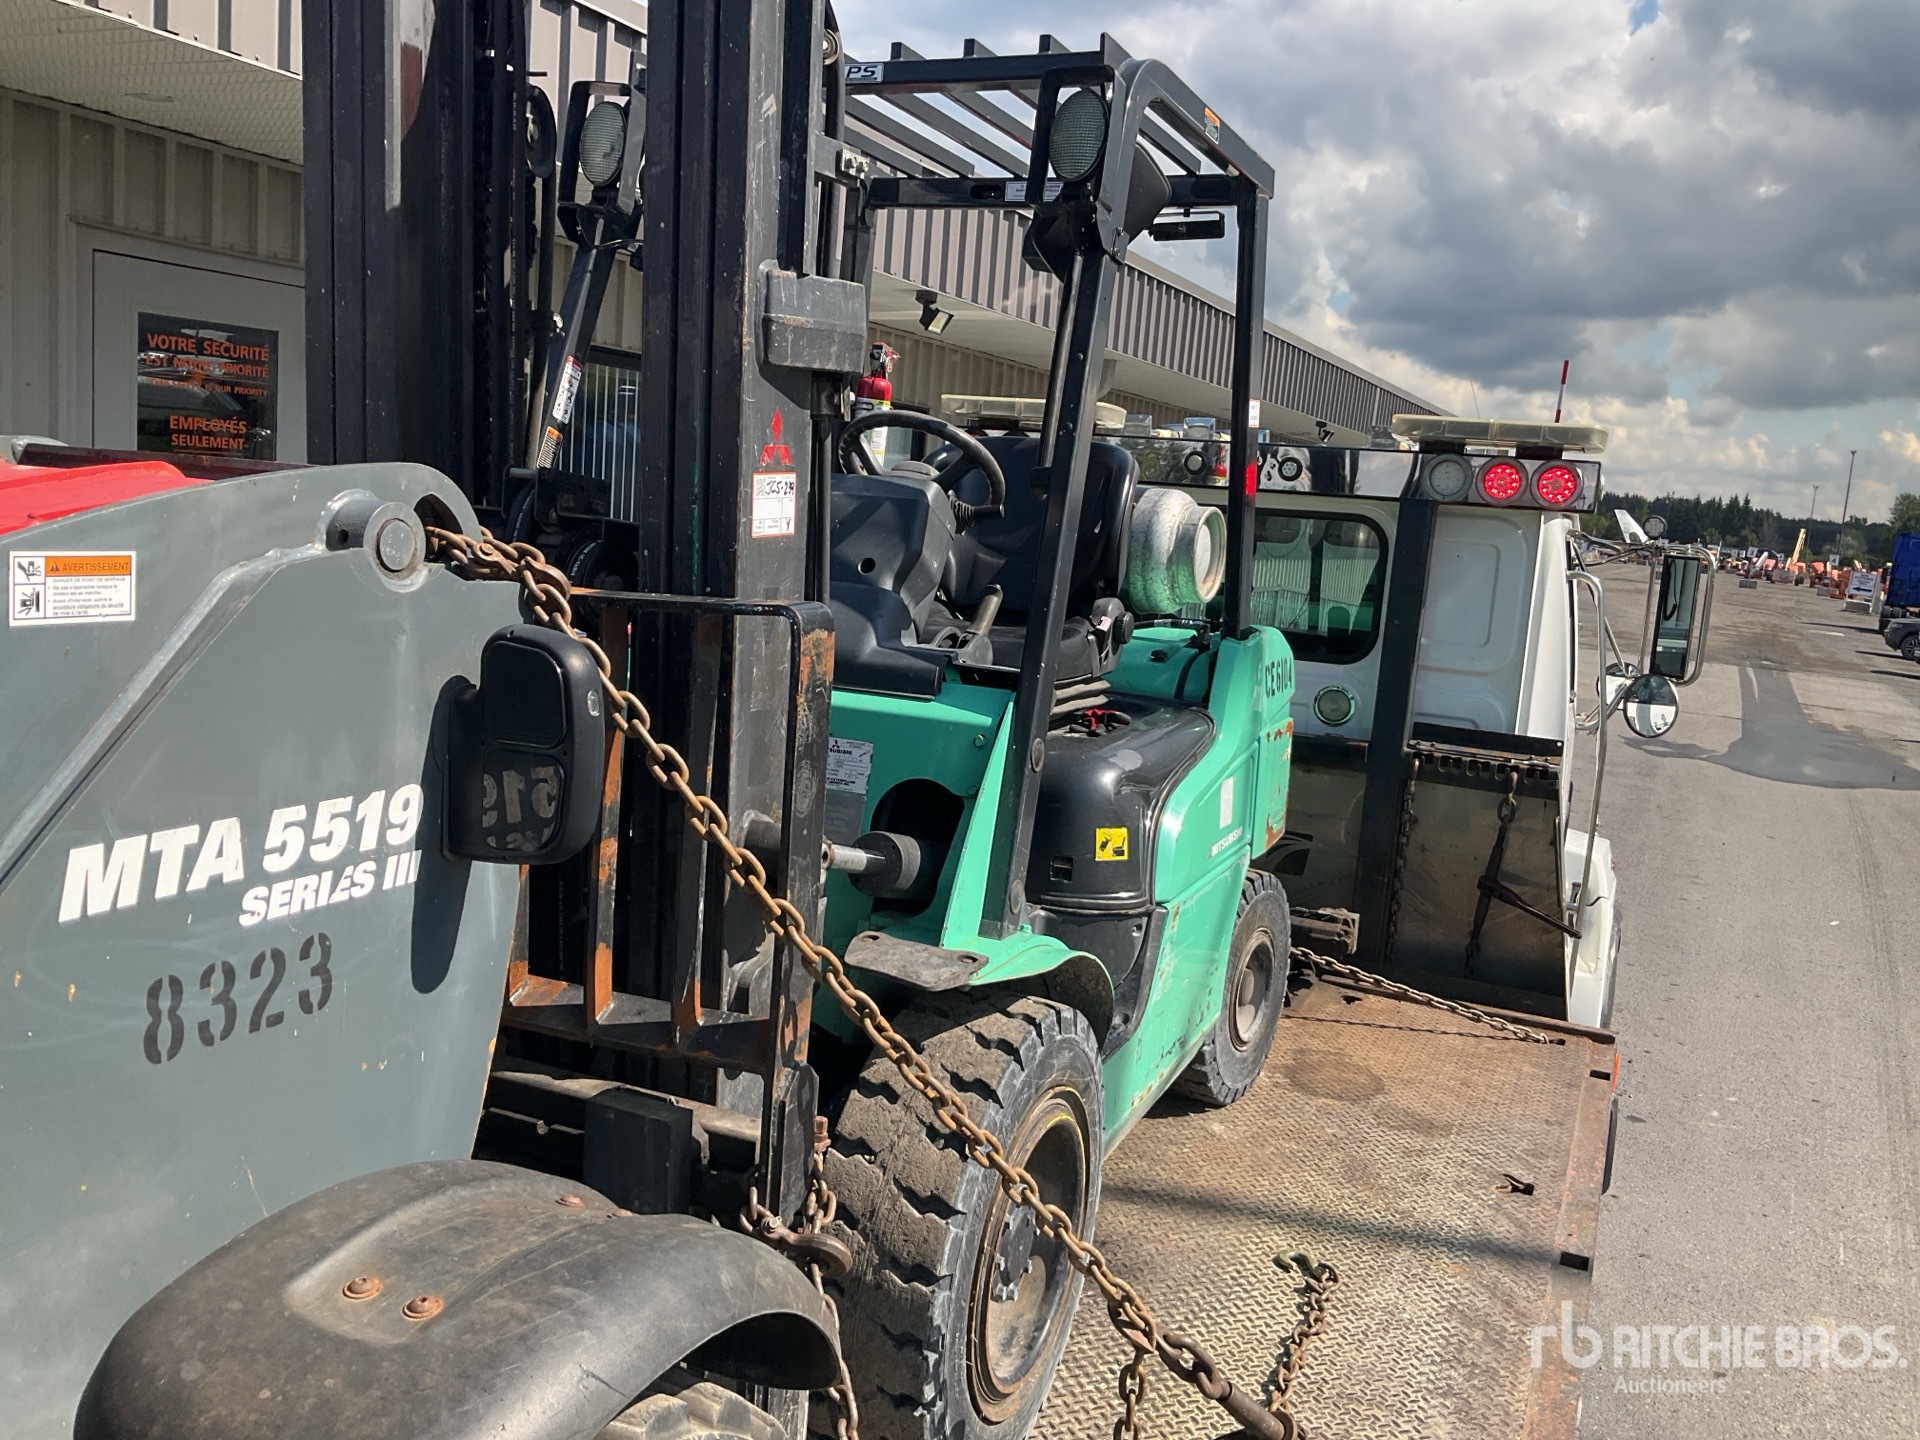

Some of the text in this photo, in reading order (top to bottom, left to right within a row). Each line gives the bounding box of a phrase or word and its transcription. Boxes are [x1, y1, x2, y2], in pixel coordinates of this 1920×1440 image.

[146, 333, 196, 353] VOTRE
[146, 354, 168, 366] EST
[234, 386, 268, 398] PRIORITY
[169, 416, 247, 434] EMPLOYÉS
[170, 434, 246, 449] SEULEMENT
[62, 562, 128, 572] AVERTISSEMENT
[58, 783, 424, 924] MTA 5519
[238, 850, 422, 928] SERIES III
[143, 932, 333, 1065] 8323
